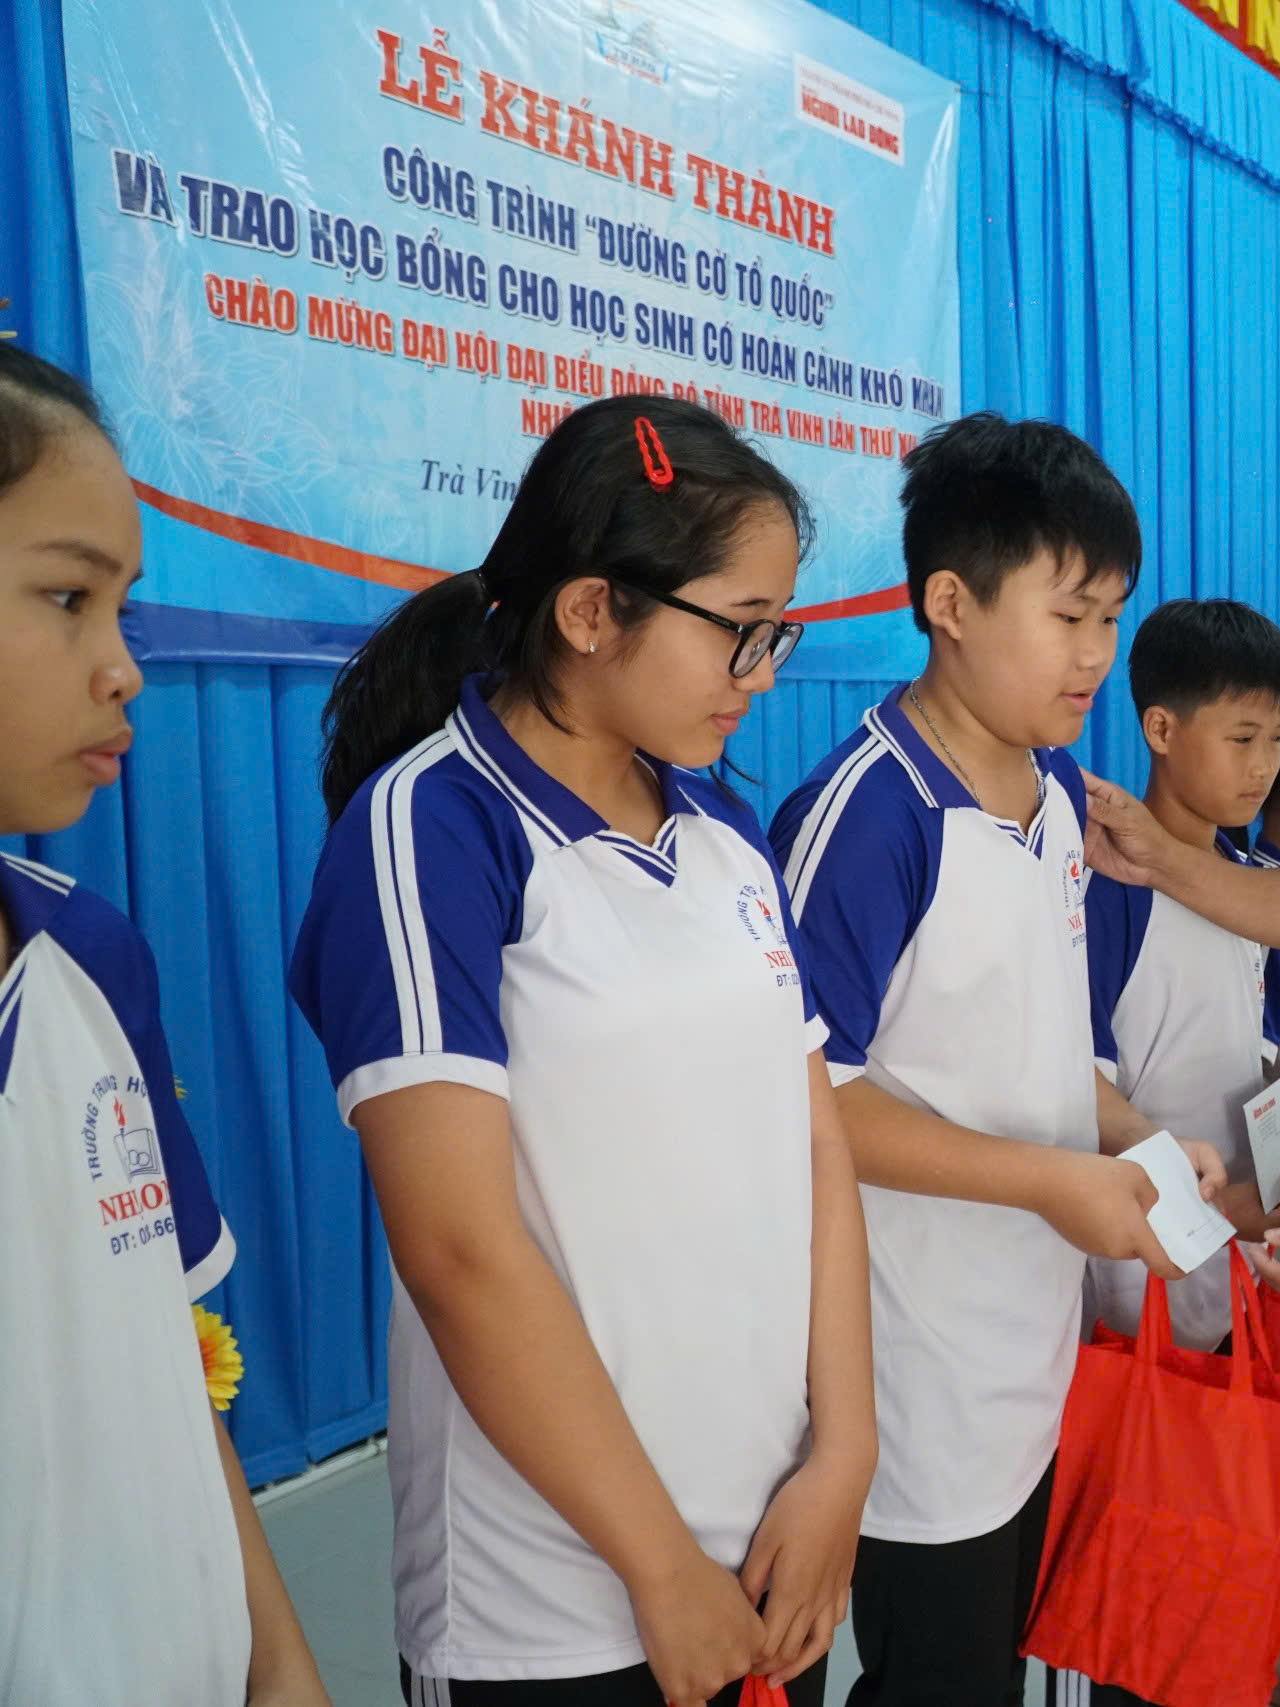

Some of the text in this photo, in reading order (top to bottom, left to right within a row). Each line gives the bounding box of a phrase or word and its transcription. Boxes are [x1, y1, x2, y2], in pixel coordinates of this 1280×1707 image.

[376, 28, 463, 121] LỄ
[479, 70, 675, 200] KHÁNH
[686, 153, 835, 257] THÀNH
[383, 146, 477, 220] CÔNG
[486, 178, 577, 251] TRÌNH
[695, 248, 727, 297] CỜ
[734, 255, 763, 307] TỔ
[113, 149, 174, 223] VÀ
[179, 174, 297, 253] TRAO
[308, 207, 384, 280] HỌC
[395, 226, 487, 304] BỔNG
[498, 263, 559, 322] CHO
[569, 283, 626, 342] HỌC
[634, 301, 695, 357] SINH
[702, 320, 734, 367] CÓ
[741, 324, 797, 384] HOÀN
[803, 346, 854, 399] CẢNH
[859, 366, 904, 408] KHÓ
[204, 272, 297, 334] CHÀO
[307, 295, 394, 355] MỪNG
[401, 318, 448, 371] ĐẠI
[454, 328, 501, 381] HỘI
[505, 343, 548, 392] ĐẠI
[553, 349, 604, 398] BIỂU
[749, 399, 783, 436] TRÀ
[786, 408, 825, 445] VINH
[828, 409, 856, 452] LẦN
[859, 425, 896, 459] THỨ
[421, 459, 520, 502] Trà Vin
